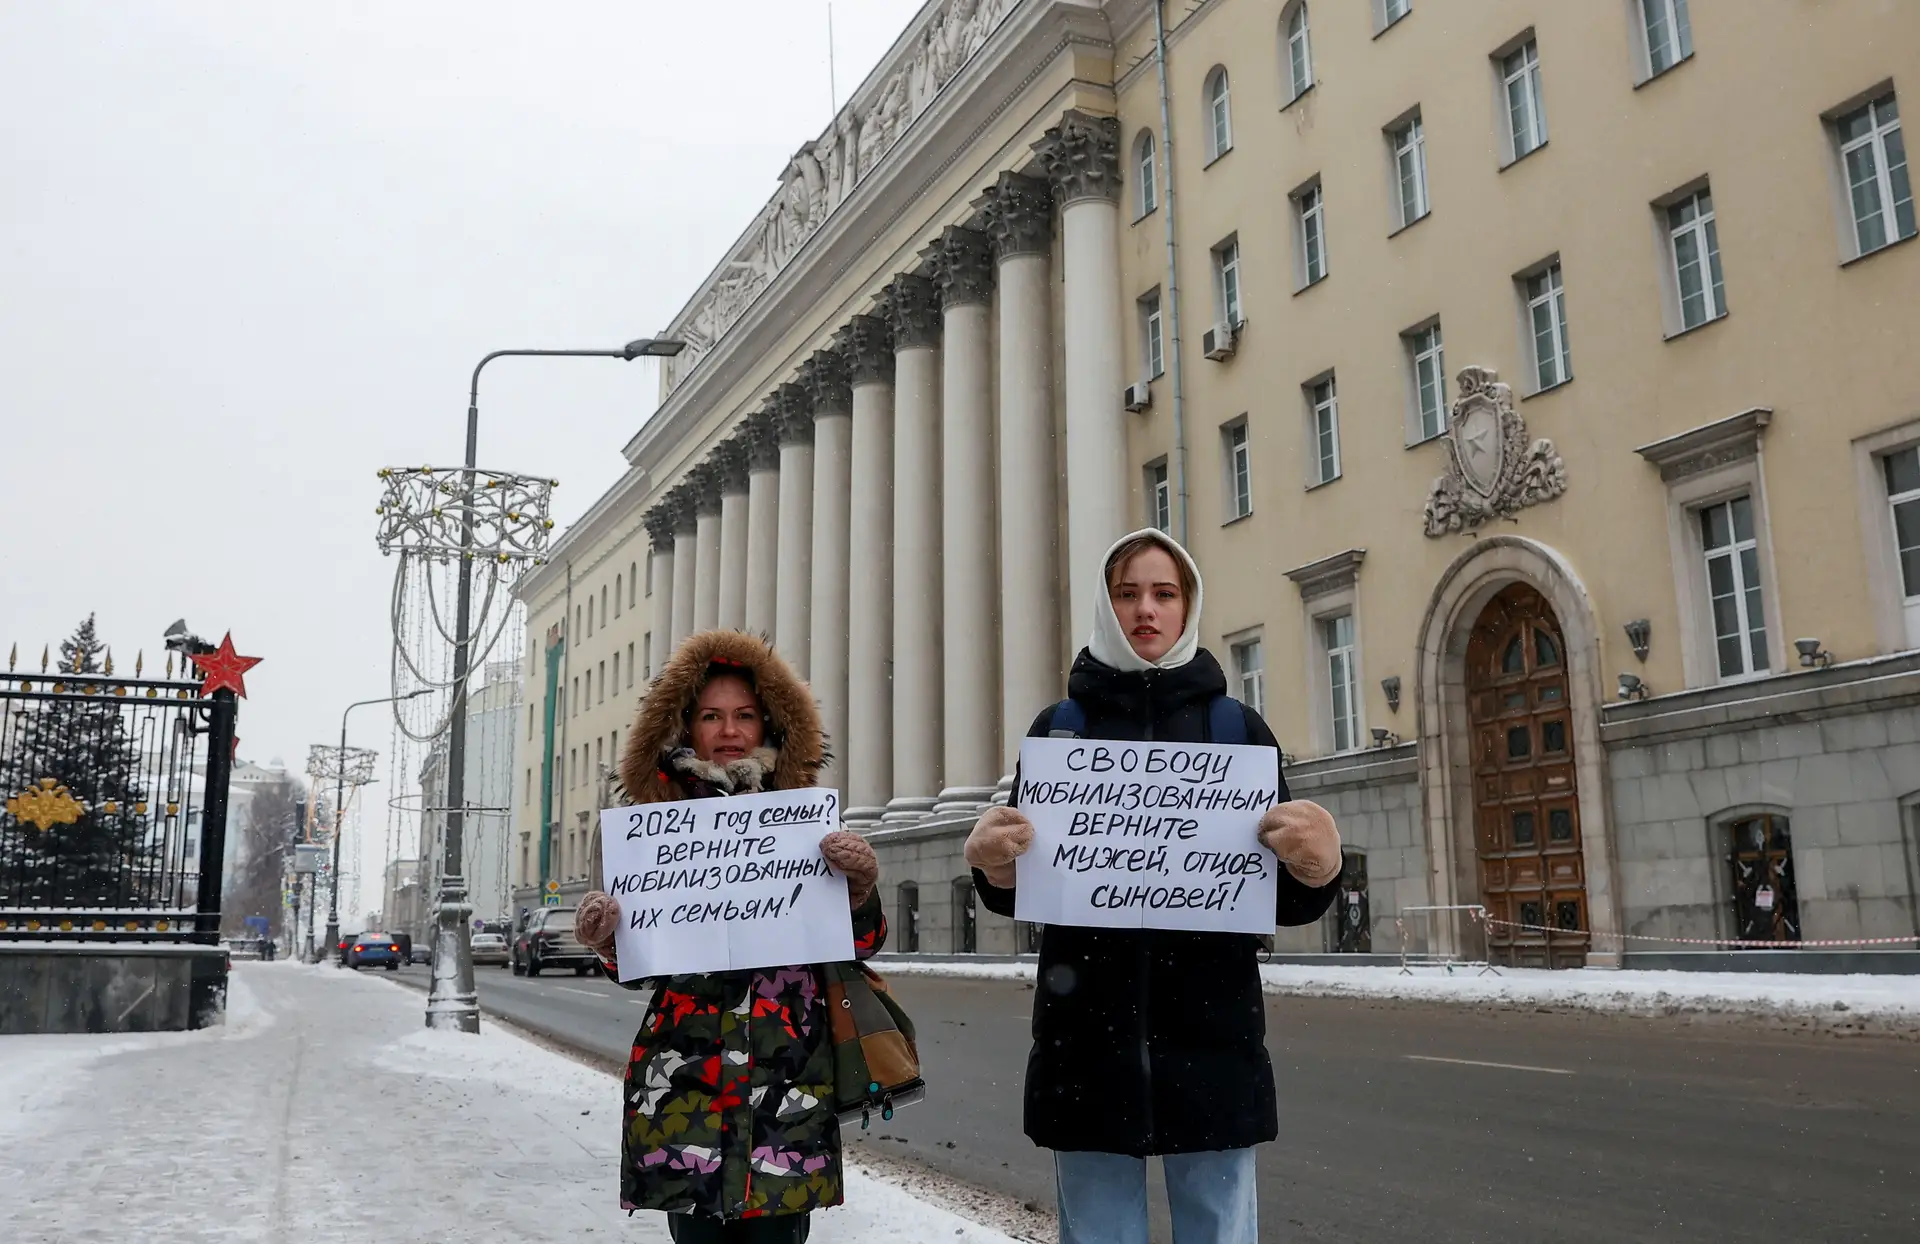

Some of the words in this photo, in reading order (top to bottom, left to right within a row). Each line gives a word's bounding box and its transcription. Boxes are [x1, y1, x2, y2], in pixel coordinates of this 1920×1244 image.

[1019, 780, 1276, 812] МОБИЛИЗОВАННЫМ
[627, 808, 696, 840] 2024
[1183, 851, 1268, 880] ОТЦОВ,
